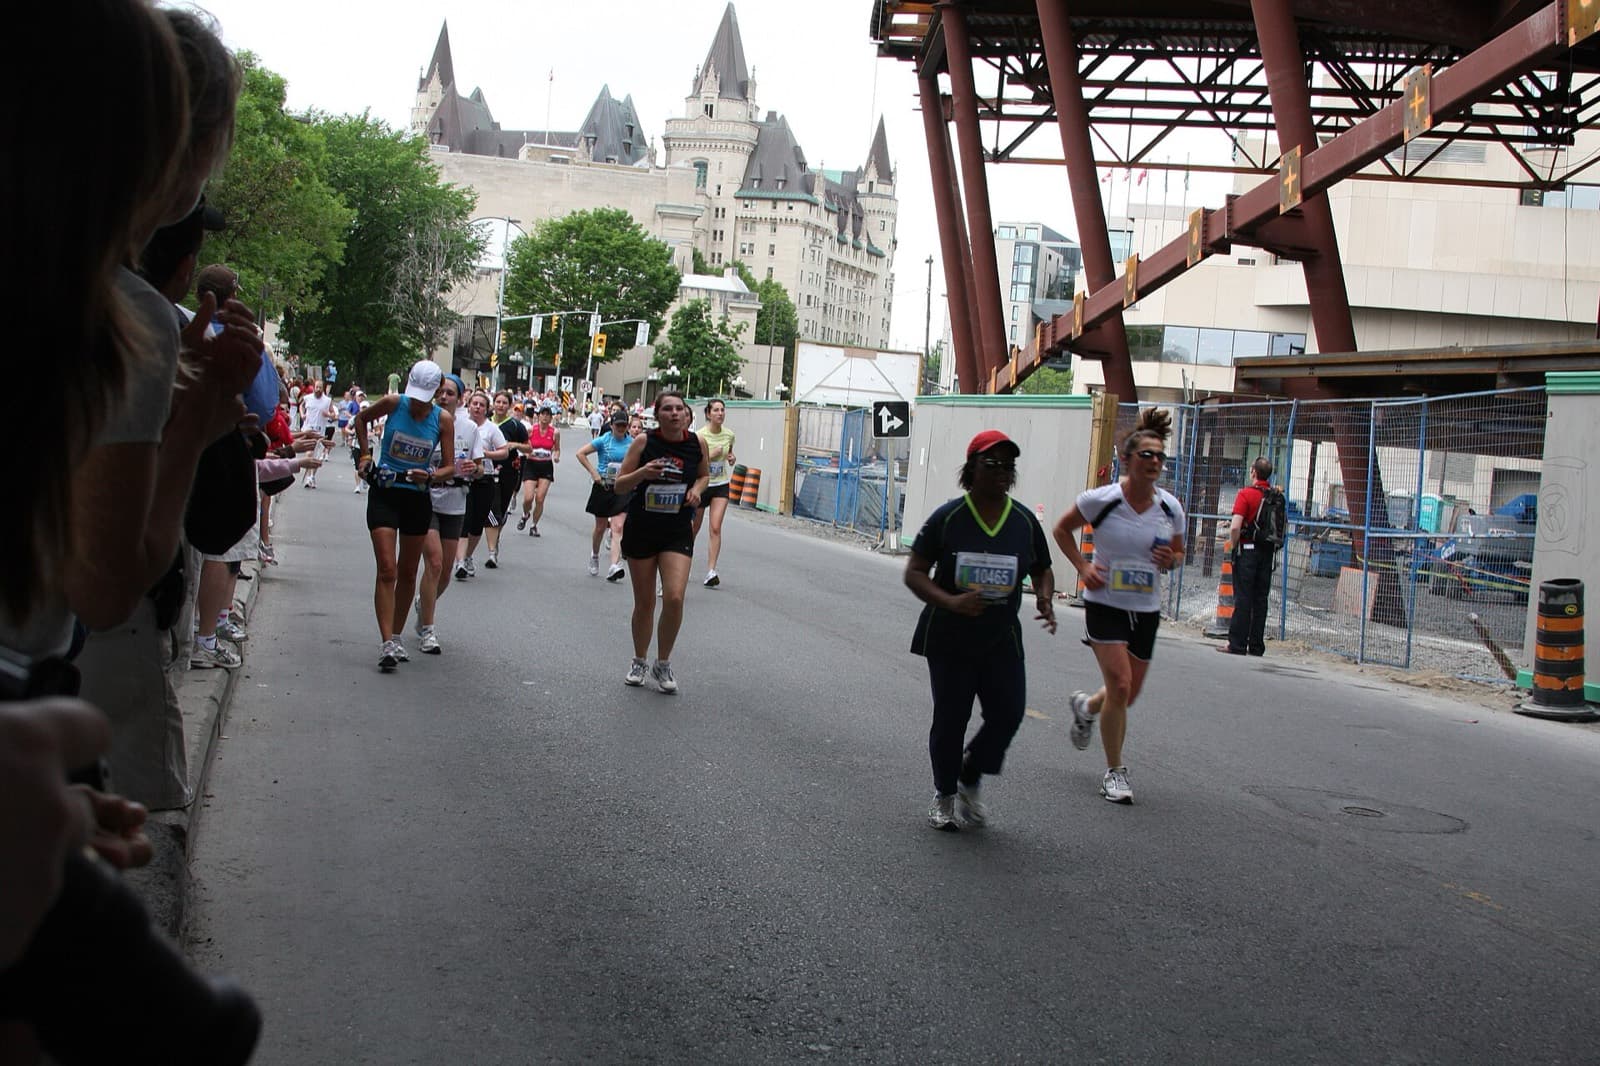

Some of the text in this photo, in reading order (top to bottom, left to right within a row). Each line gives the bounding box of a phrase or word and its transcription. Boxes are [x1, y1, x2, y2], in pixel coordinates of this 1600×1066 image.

[404, 446, 424, 458] 5476
[660, 494, 679, 505] 7771
[975, 568, 1009, 585] 10465
